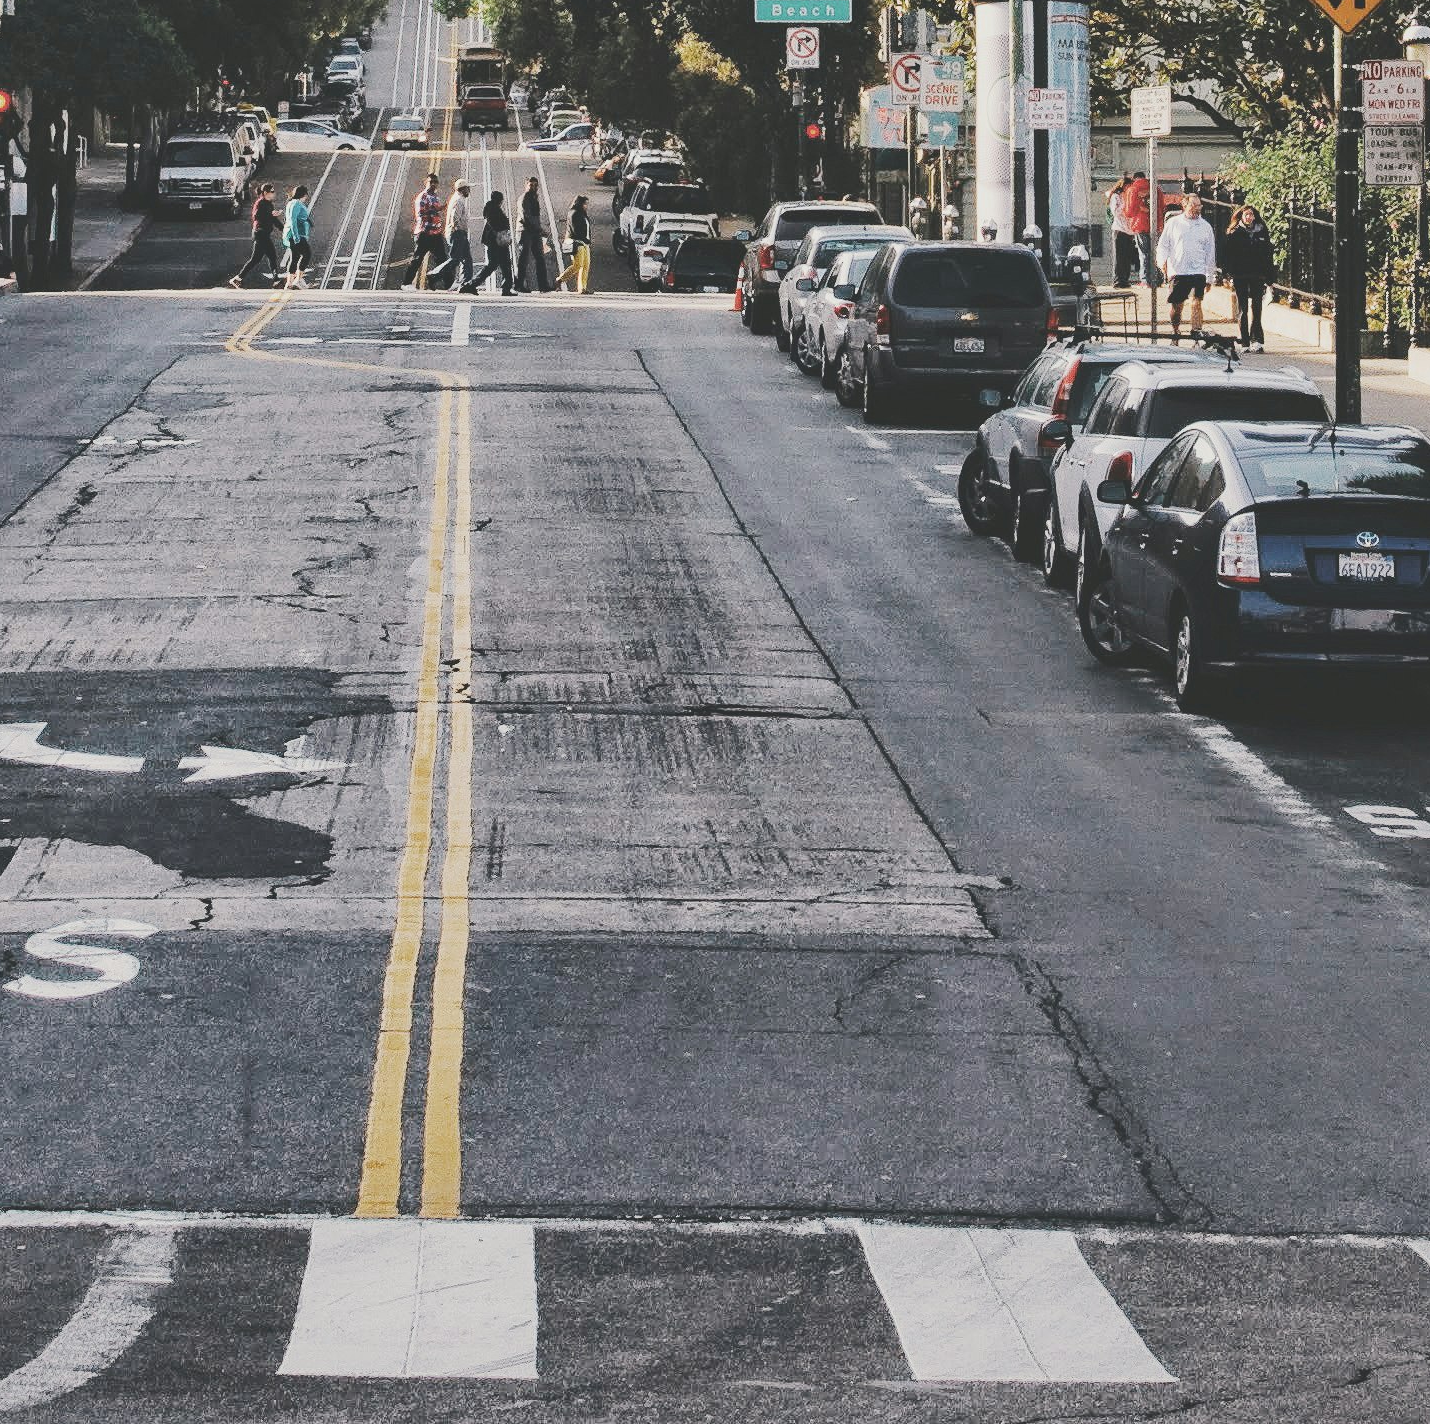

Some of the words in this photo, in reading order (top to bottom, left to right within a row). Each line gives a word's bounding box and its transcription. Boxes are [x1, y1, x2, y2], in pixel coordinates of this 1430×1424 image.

[771, 4, 836, 17] Beach
[1364, 62, 1381, 79] NO
[1383, 66, 1422, 78] PARKING
[925, 84, 958, 94] SCENIC
[925, 95, 958, 106] DRIVE
[1368, 100, 1386, 109] MON
[1388, 99, 1406, 109] WED
[1371, 127, 1394, 137] TOUR
[1400, 127, 1419, 137] BUS
